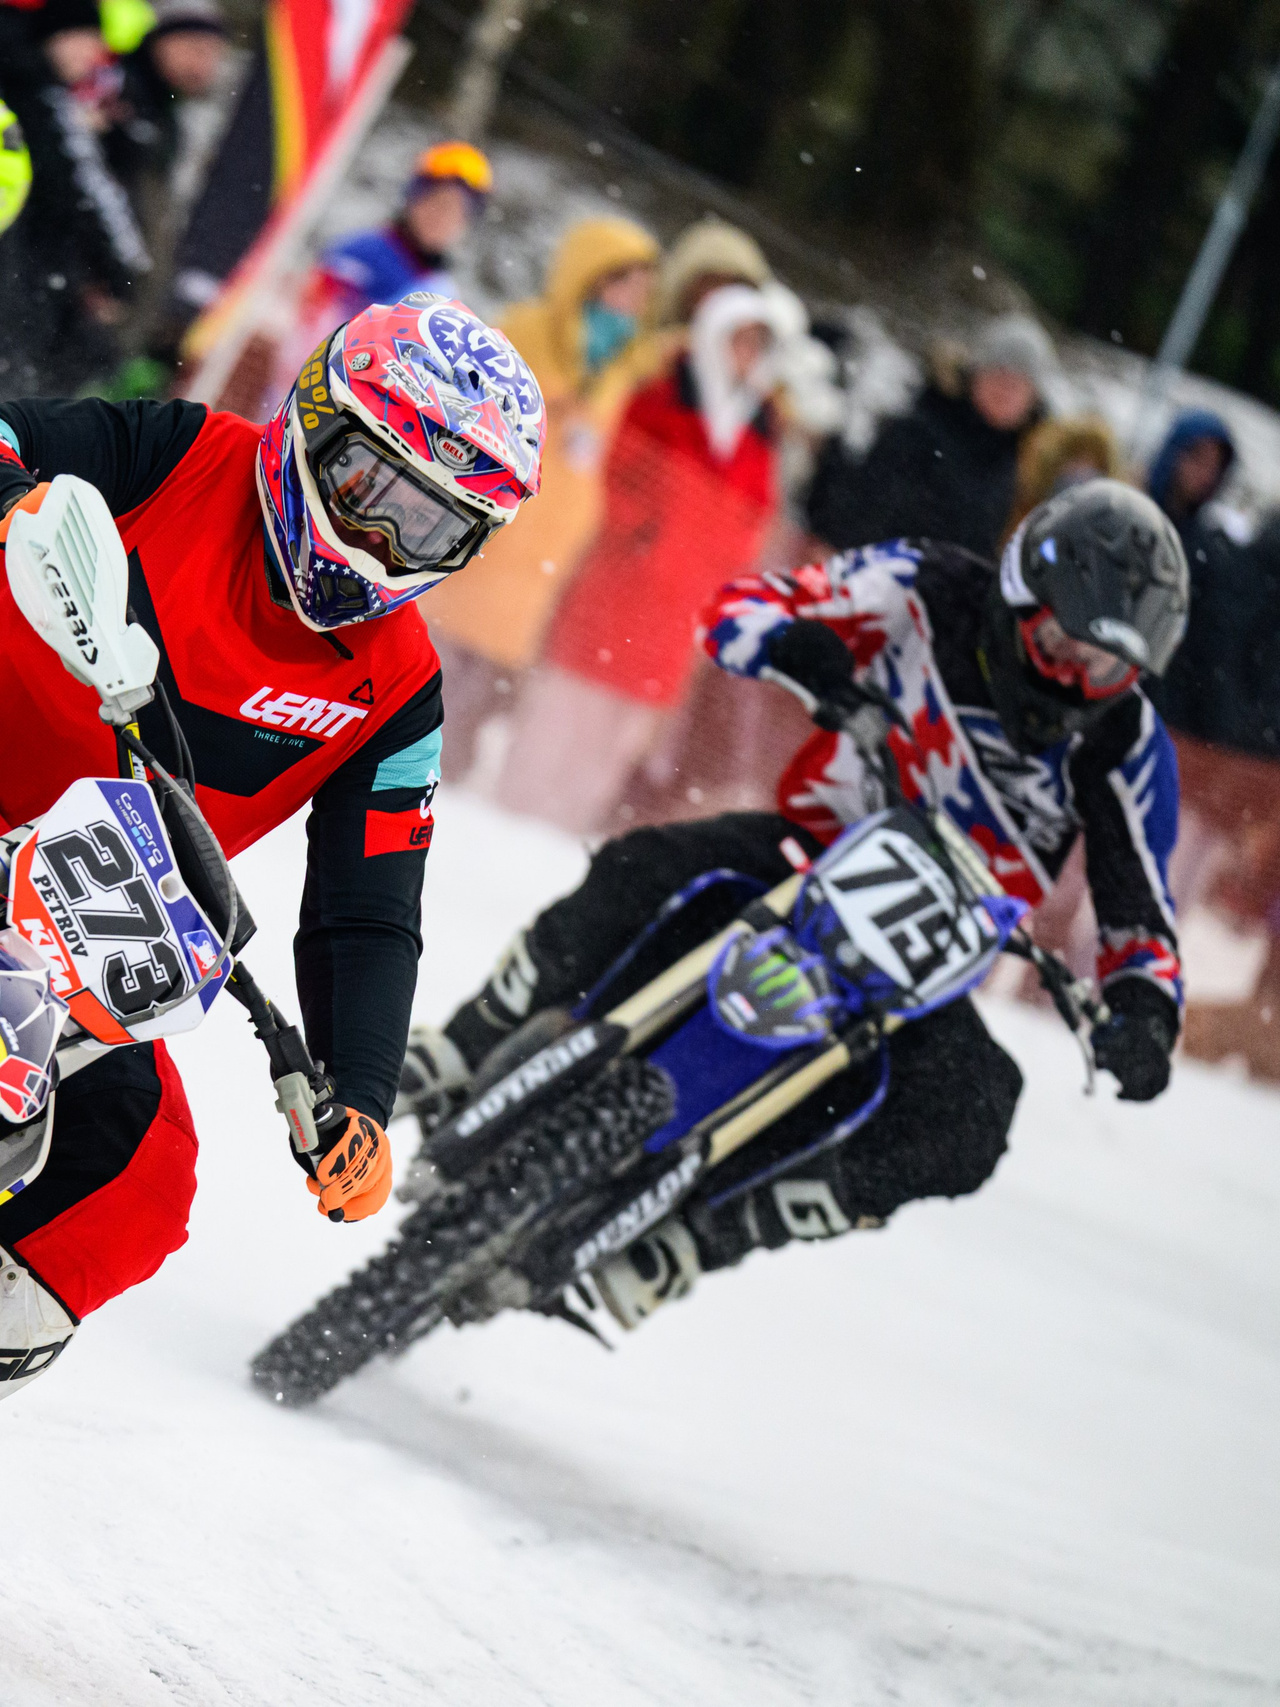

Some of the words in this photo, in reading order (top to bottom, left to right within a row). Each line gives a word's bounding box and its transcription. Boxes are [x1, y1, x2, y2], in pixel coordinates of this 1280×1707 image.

[442, 441, 465, 461] BELL
[239, 686, 369, 738] LEATT
[254, 730, 281, 743] THREE
[120, 792, 164, 864] GoPro
[33, 875, 88, 957] PETROV
[35, 819, 190, 1018] 273
[830, 841, 973, 989] 715
[19, 918, 74, 999] KTM
[456, 1027, 599, 1137] DUNLOP
[574, 1152, 704, 1270] DUNLOP
